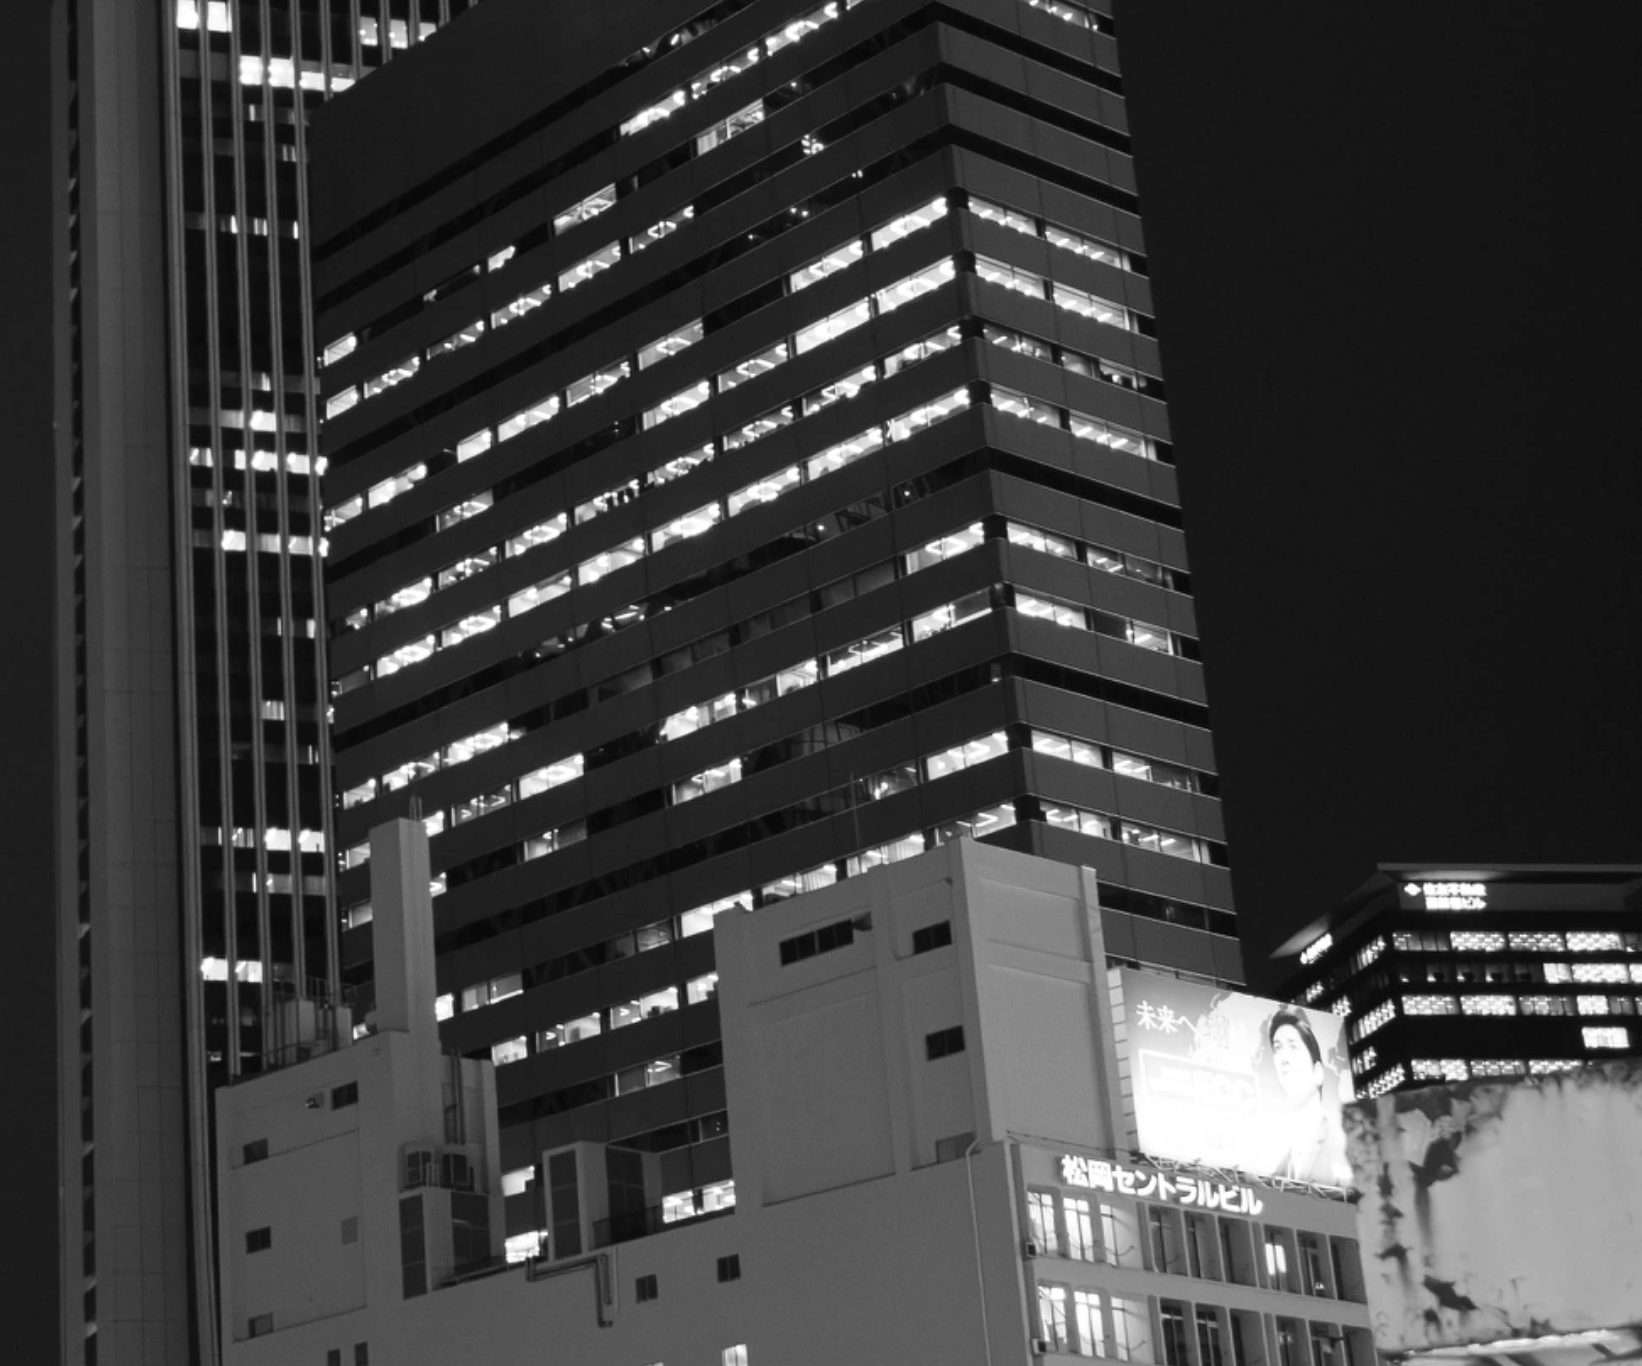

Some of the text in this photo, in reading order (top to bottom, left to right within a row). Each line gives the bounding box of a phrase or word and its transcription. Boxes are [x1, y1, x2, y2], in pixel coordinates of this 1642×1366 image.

[1061, 1153, 1264, 1216] 松岡セントラルビル
